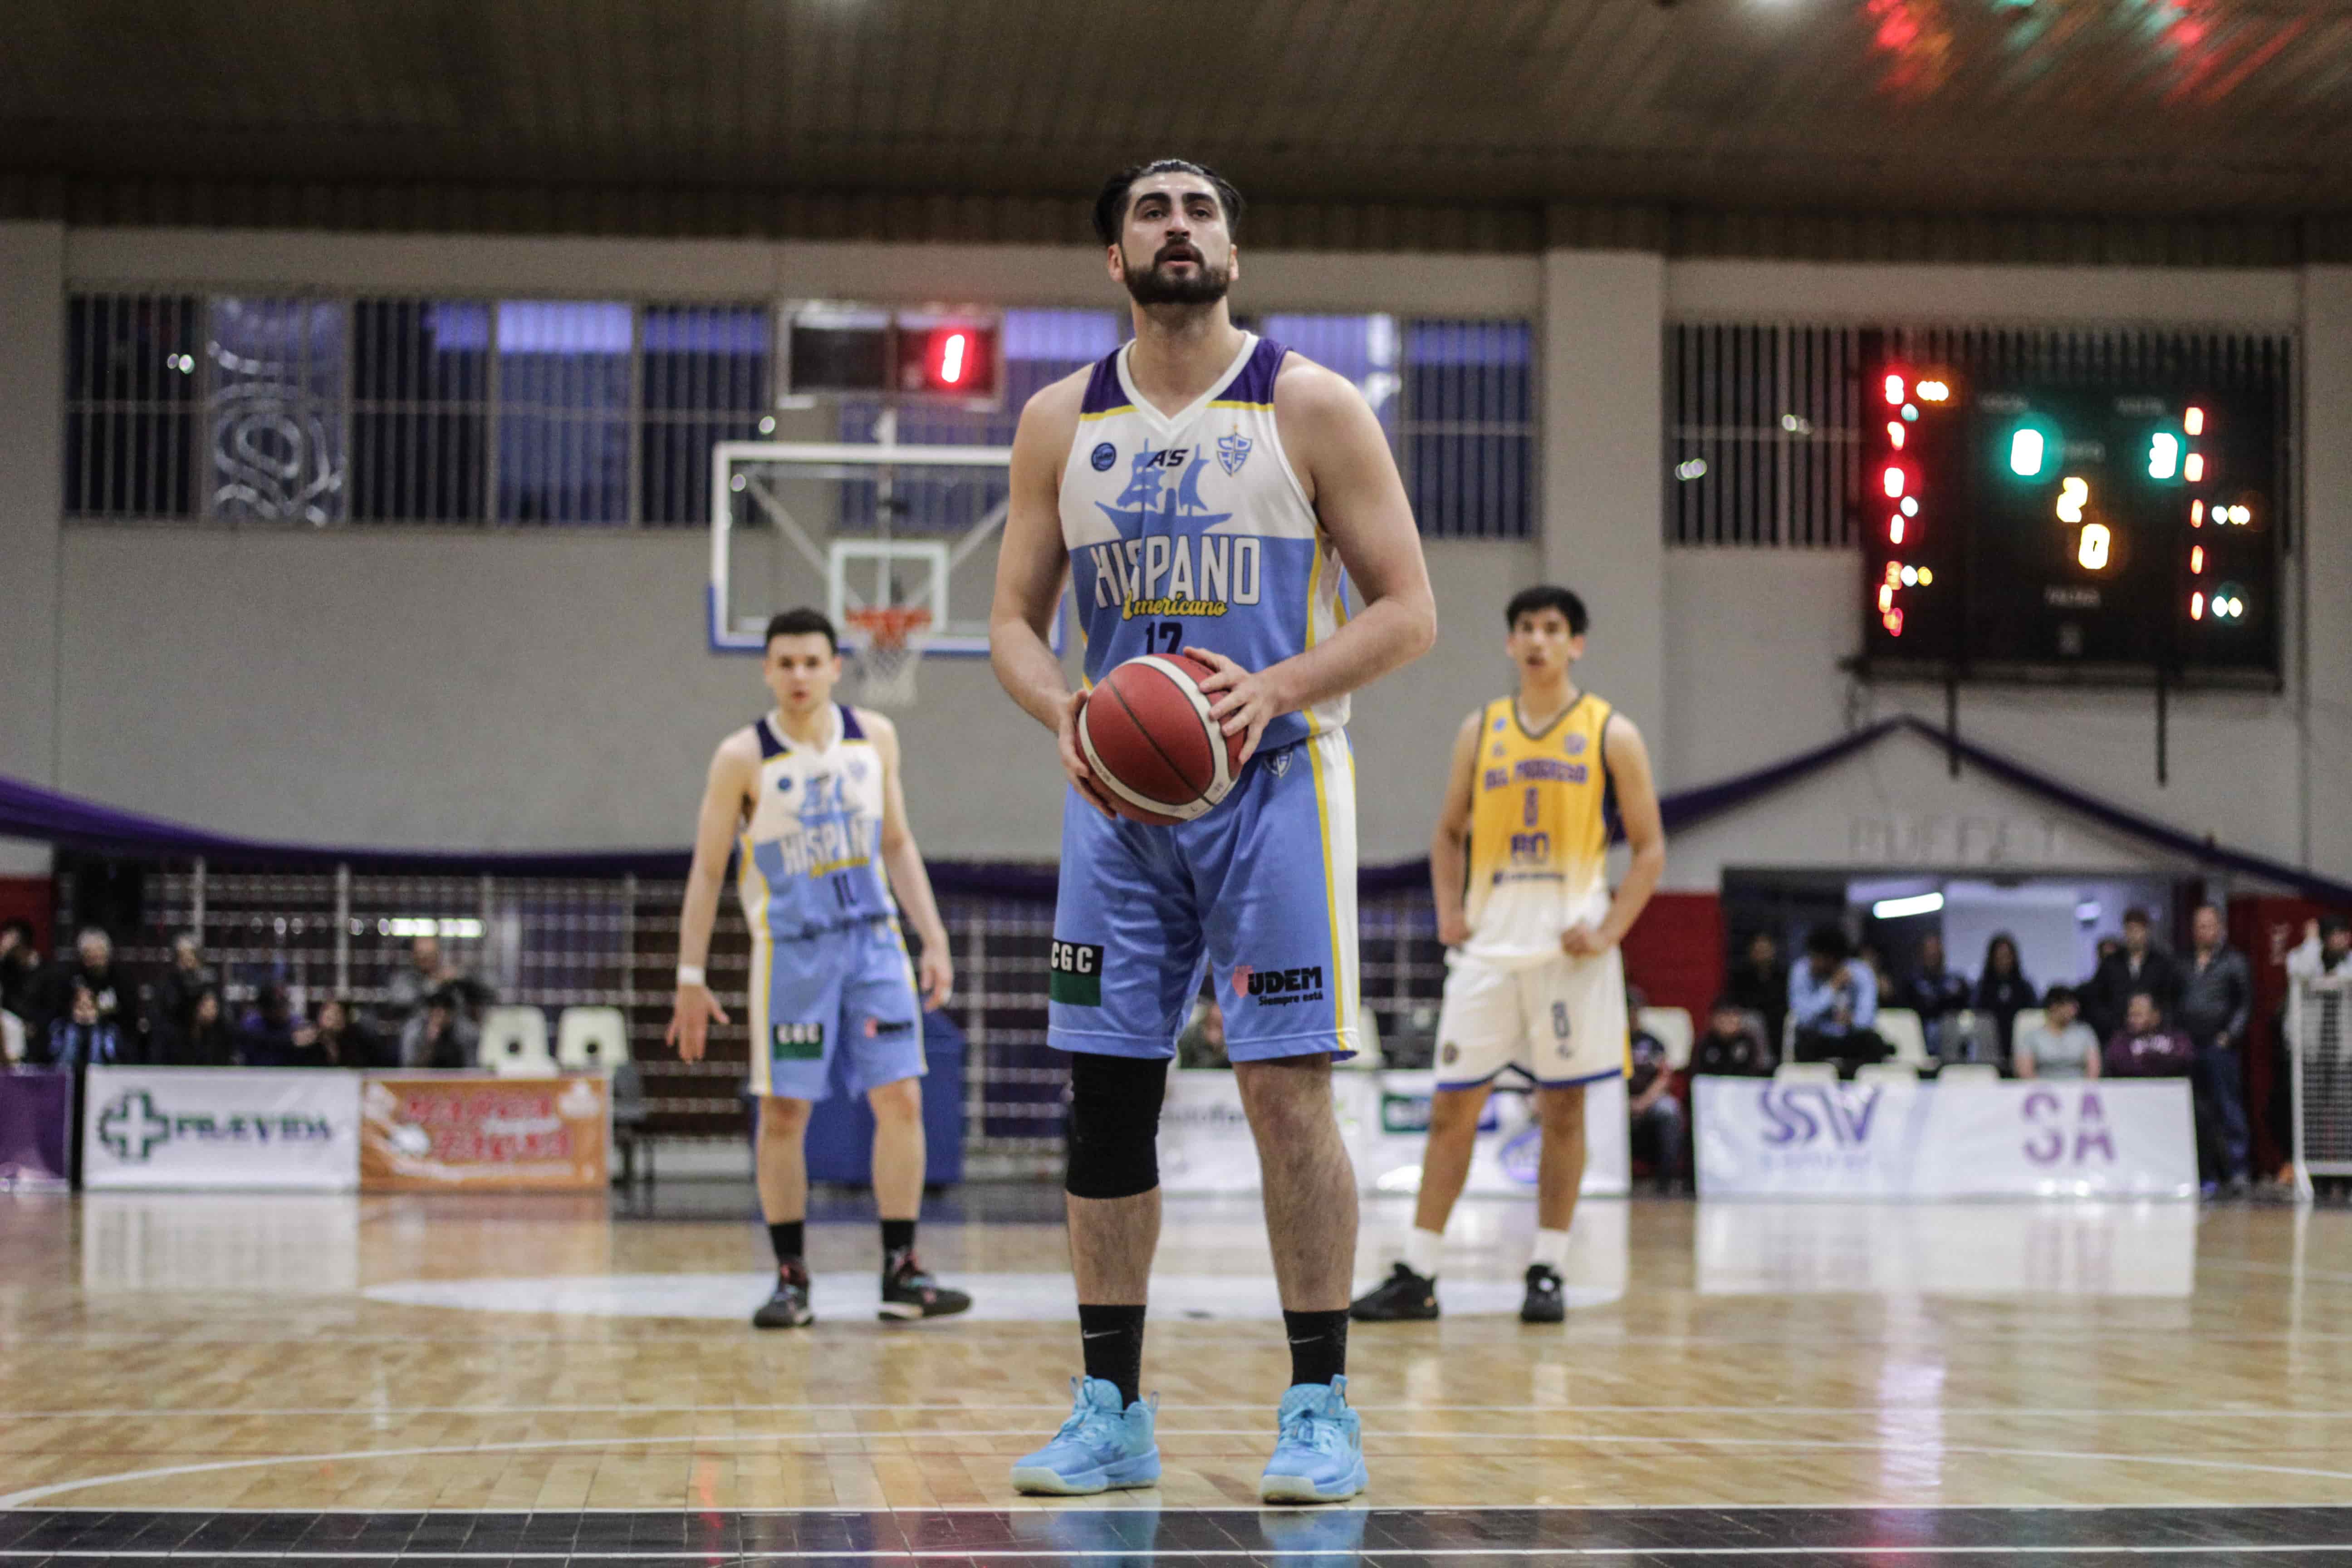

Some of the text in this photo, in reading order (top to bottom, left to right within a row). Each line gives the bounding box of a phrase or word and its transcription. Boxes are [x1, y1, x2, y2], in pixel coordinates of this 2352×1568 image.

[1090, 535, 1259, 608] HISPANO
[779, 815, 874, 877] HISPAN
[1248, 966, 1323, 995] UDEM
